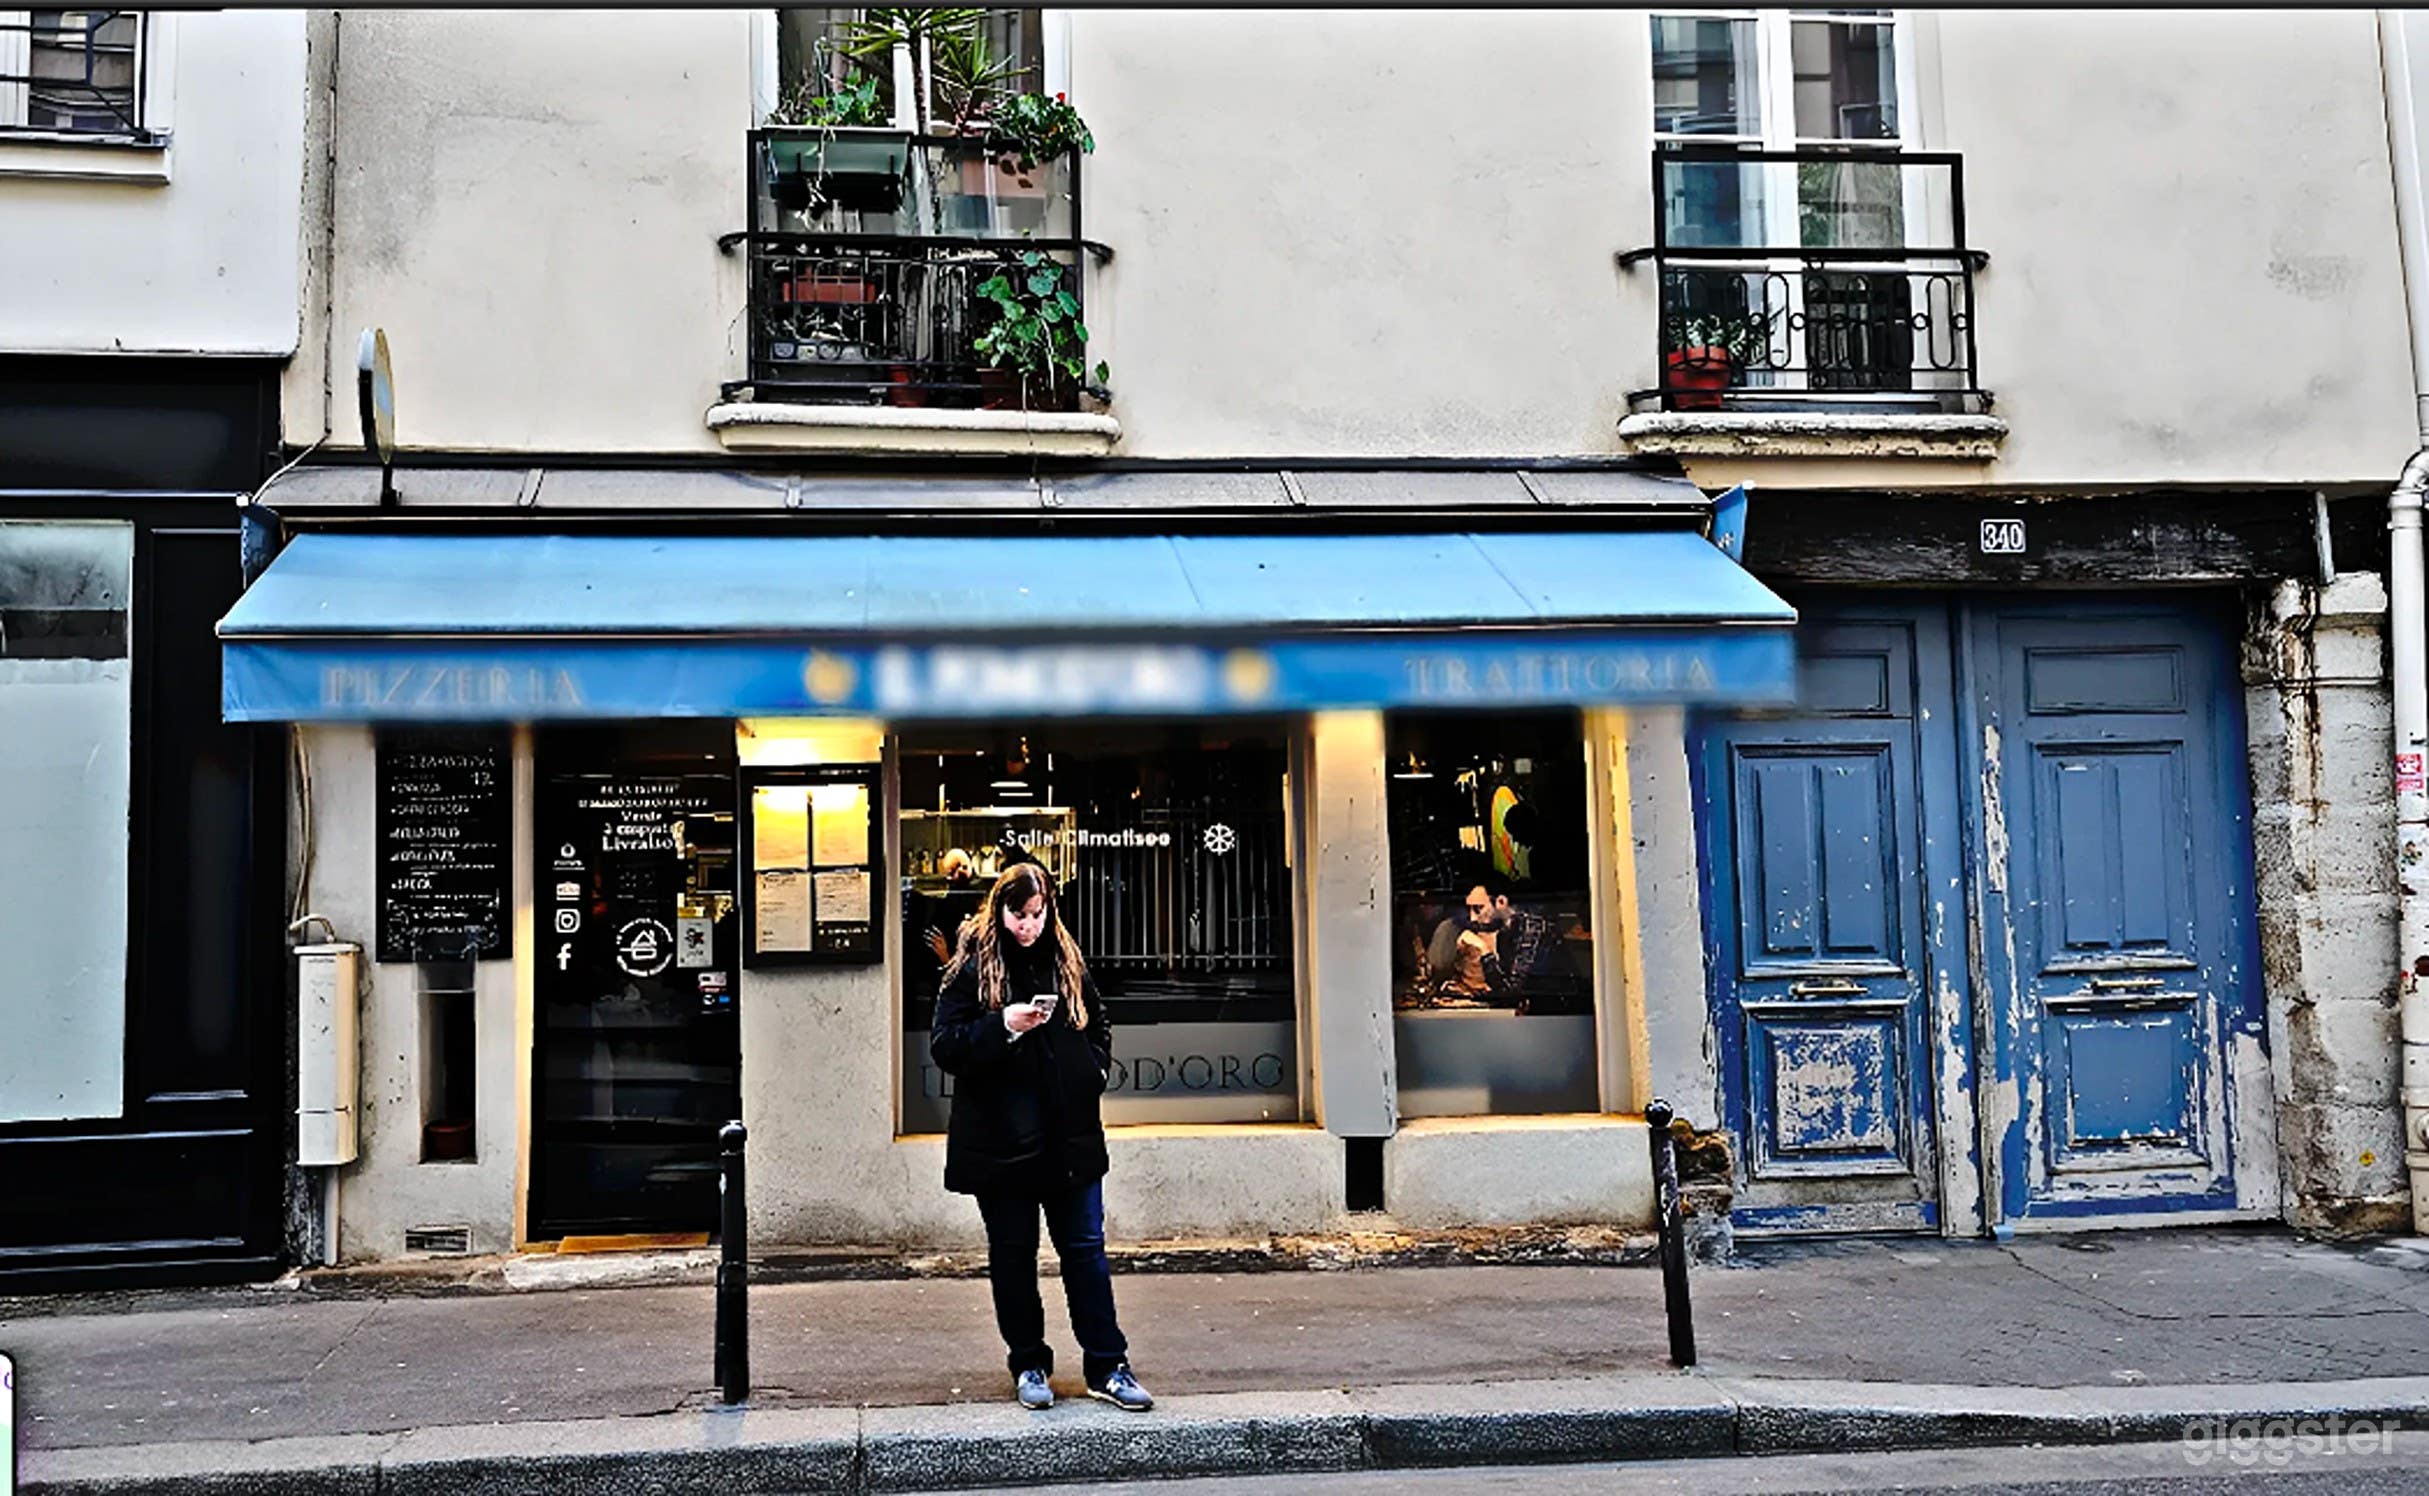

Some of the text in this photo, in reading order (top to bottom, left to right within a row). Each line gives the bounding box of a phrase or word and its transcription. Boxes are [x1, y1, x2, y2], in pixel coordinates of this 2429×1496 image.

[1985, 524, 2023, 550] 340
[320, 664, 583, 708] PIZZERIA
[1405, 652, 1715, 698] TRATTORIA
